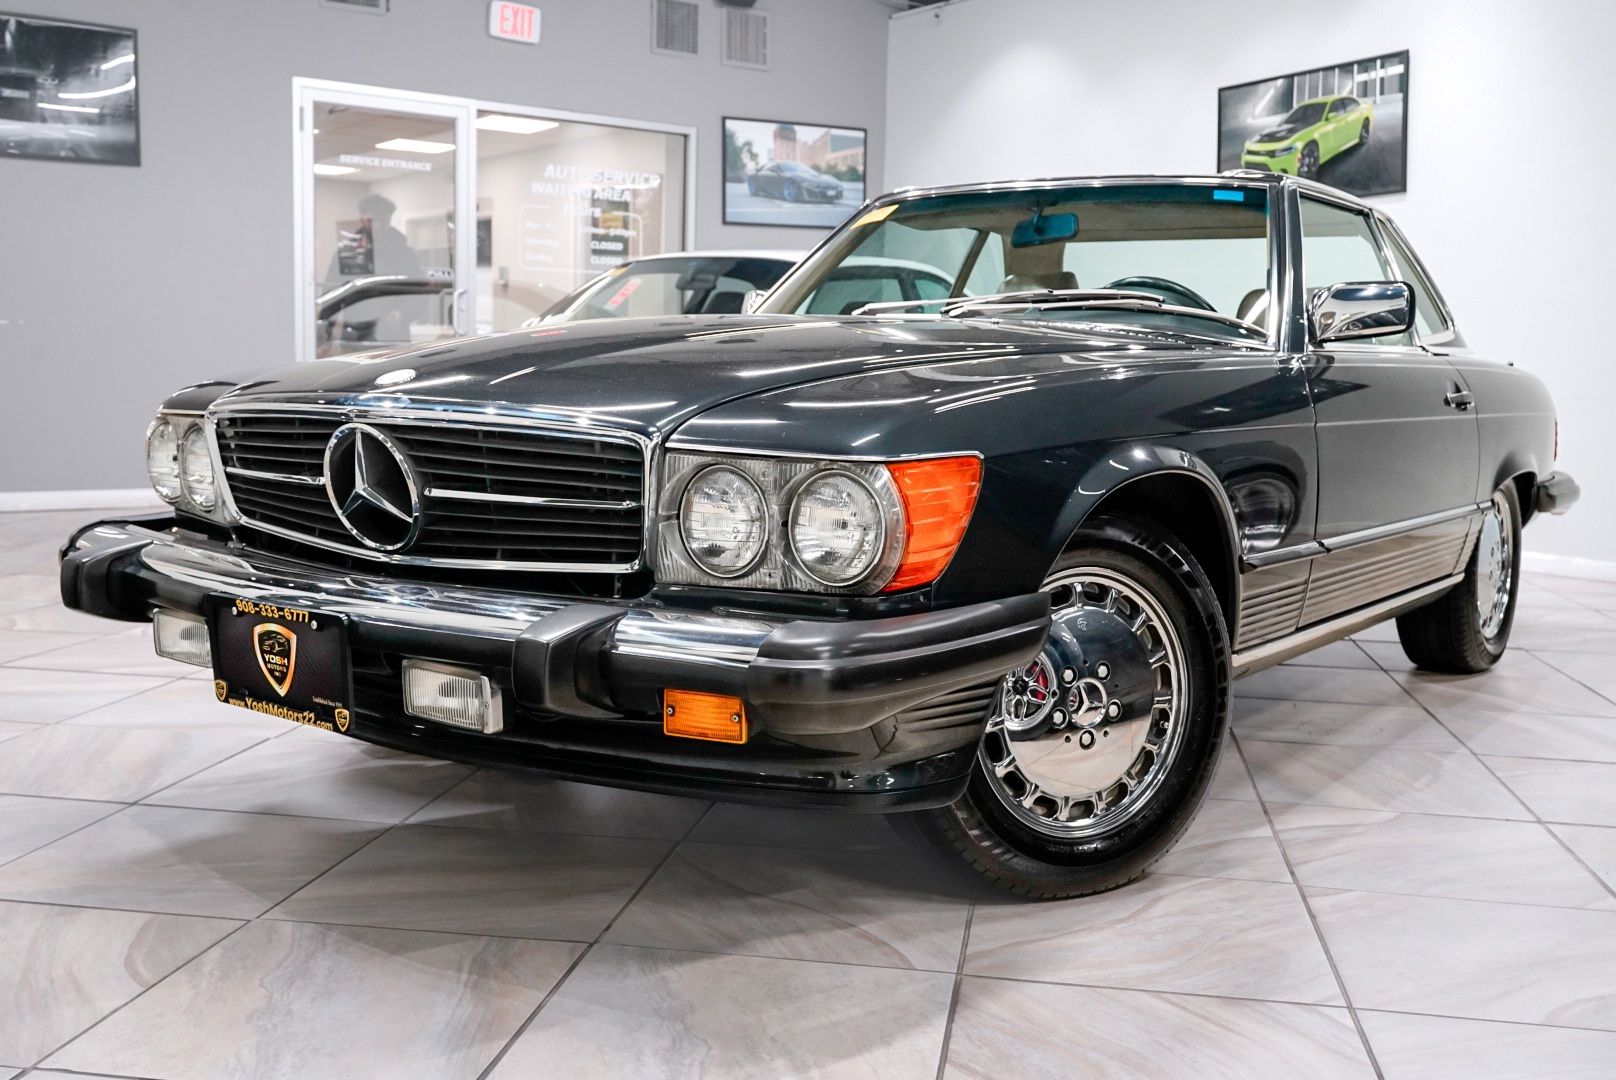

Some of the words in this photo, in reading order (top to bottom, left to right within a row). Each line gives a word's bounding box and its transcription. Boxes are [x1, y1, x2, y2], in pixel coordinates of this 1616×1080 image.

[499, 4, 536, 37] EXIT
[339, 154, 380, 167] SERVICE
[381, 158, 432, 171] ENTRANCE
[592, 169, 661, 189] SERVICE
[593, 188, 630, 201] AREA
[590, 240, 624, 251] CLOSED
[236, 599, 309, 623] 908-333-6777
[264, 653, 288, 666] YOSH
